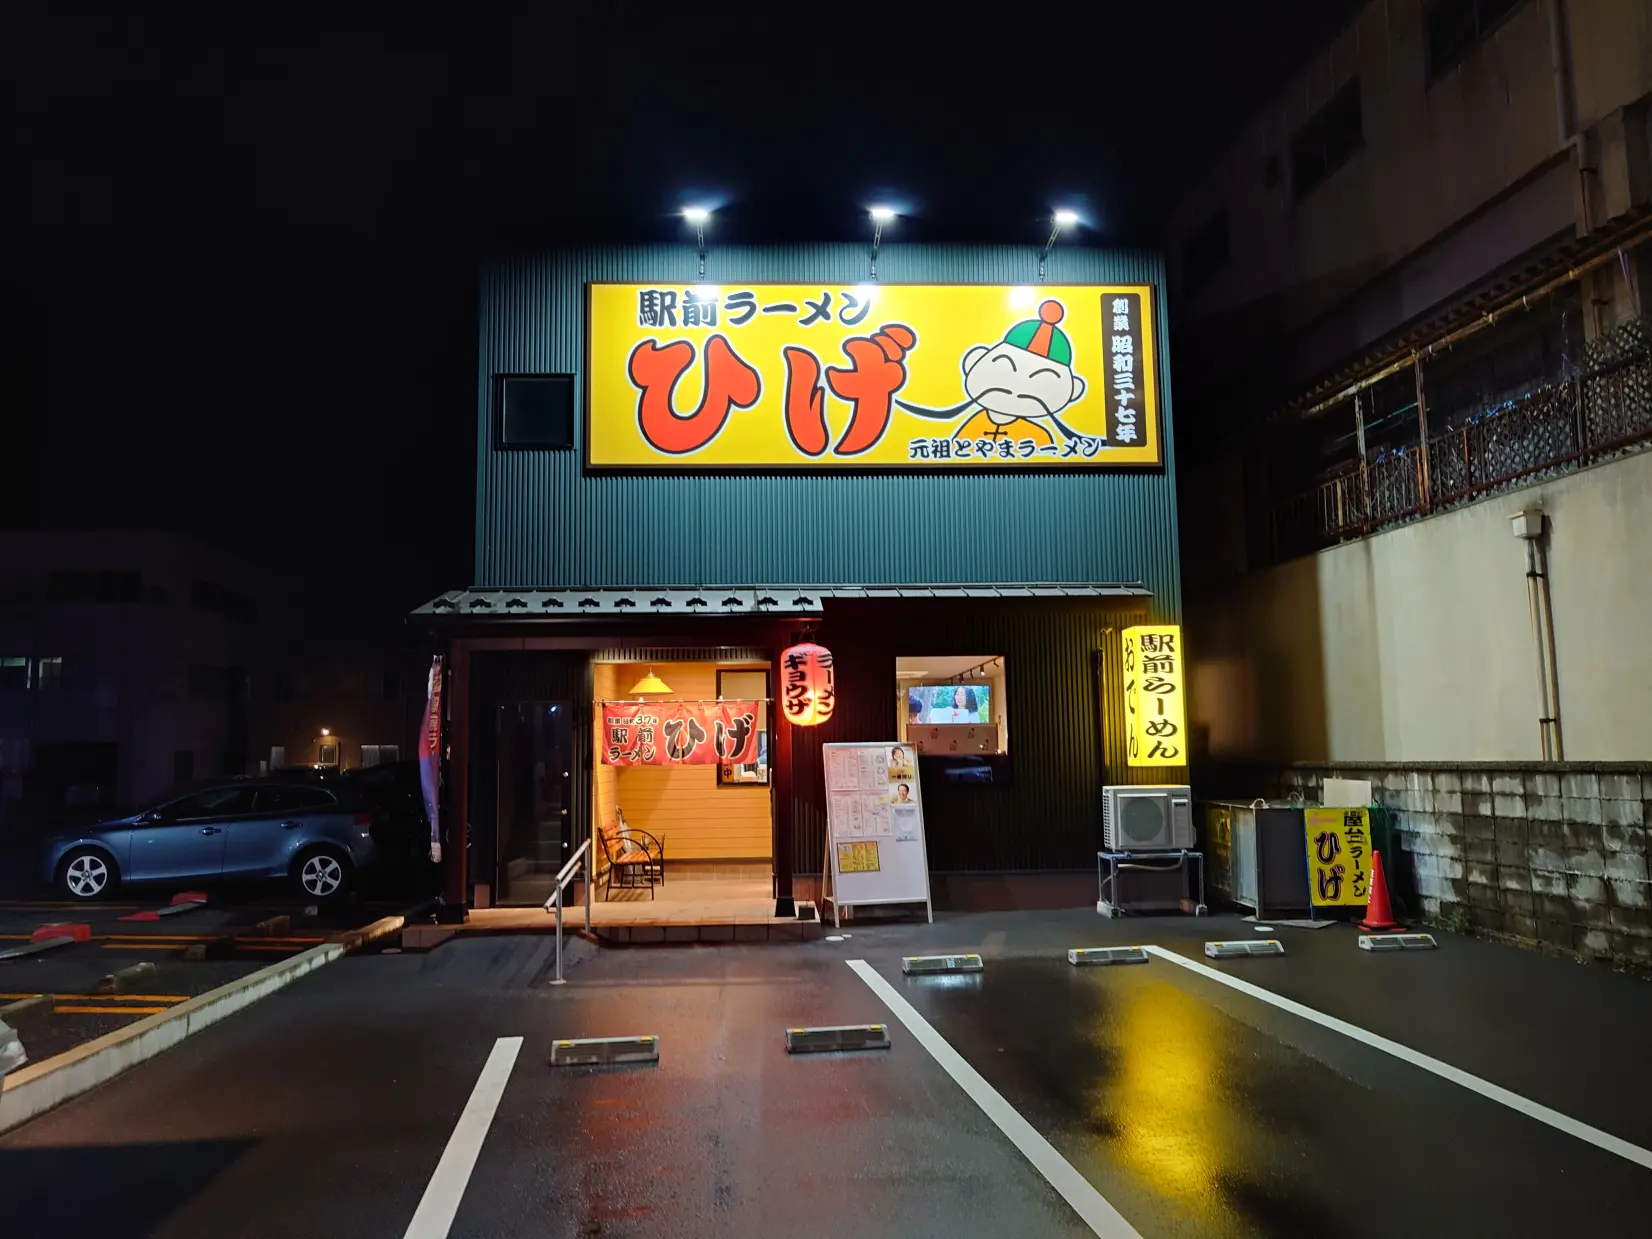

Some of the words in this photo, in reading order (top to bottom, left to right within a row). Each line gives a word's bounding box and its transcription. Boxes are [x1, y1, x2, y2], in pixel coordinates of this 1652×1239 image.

[637, 289, 873, 328] 駅前ラーメン
[628, 323, 917, 457] ひげ
[907, 438, 1101, 460] 元祖とやまラーメン
[816, 652, 835, 716] ラーメン
[1124, 636, 1139, 759] おでん
[1140, 633, 1179, 759] 駅前らーめん
[608, 745, 656, 762] ラーメン
[611, 727, 654, 745] 駅前
[663, 713, 754, 760] ひげ
[1314, 831, 1345, 901] ひげ
[1343, 811, 1367, 898] 屋台ラーメン
